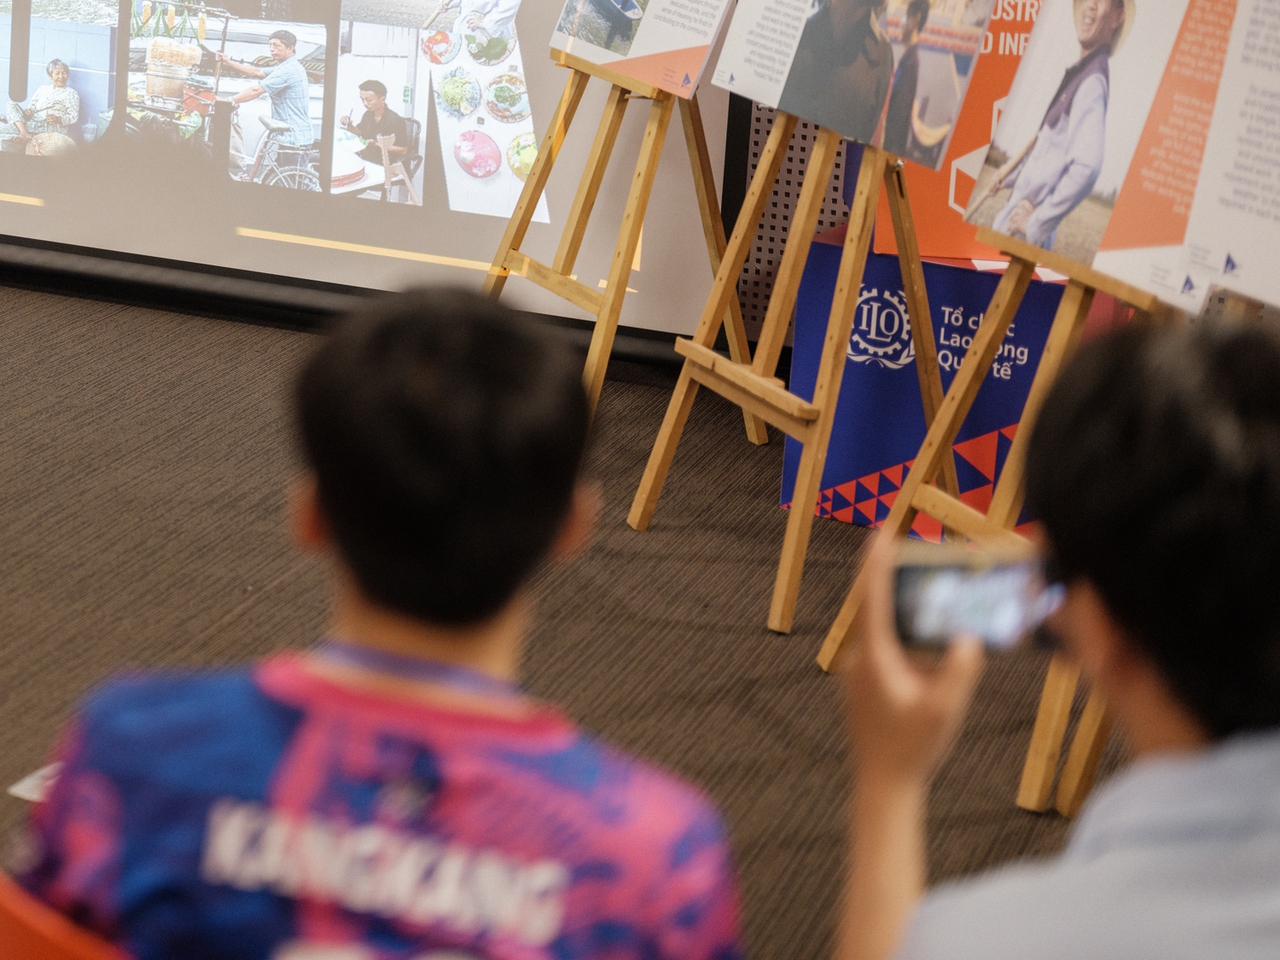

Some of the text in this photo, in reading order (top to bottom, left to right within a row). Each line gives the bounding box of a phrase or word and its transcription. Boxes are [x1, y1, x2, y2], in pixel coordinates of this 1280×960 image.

[859, 301, 900, 343] ILO
[941, 306, 964, 327] Tổ
[939, 327, 973, 349] Lao
[992, 360, 1014, 380] tế
